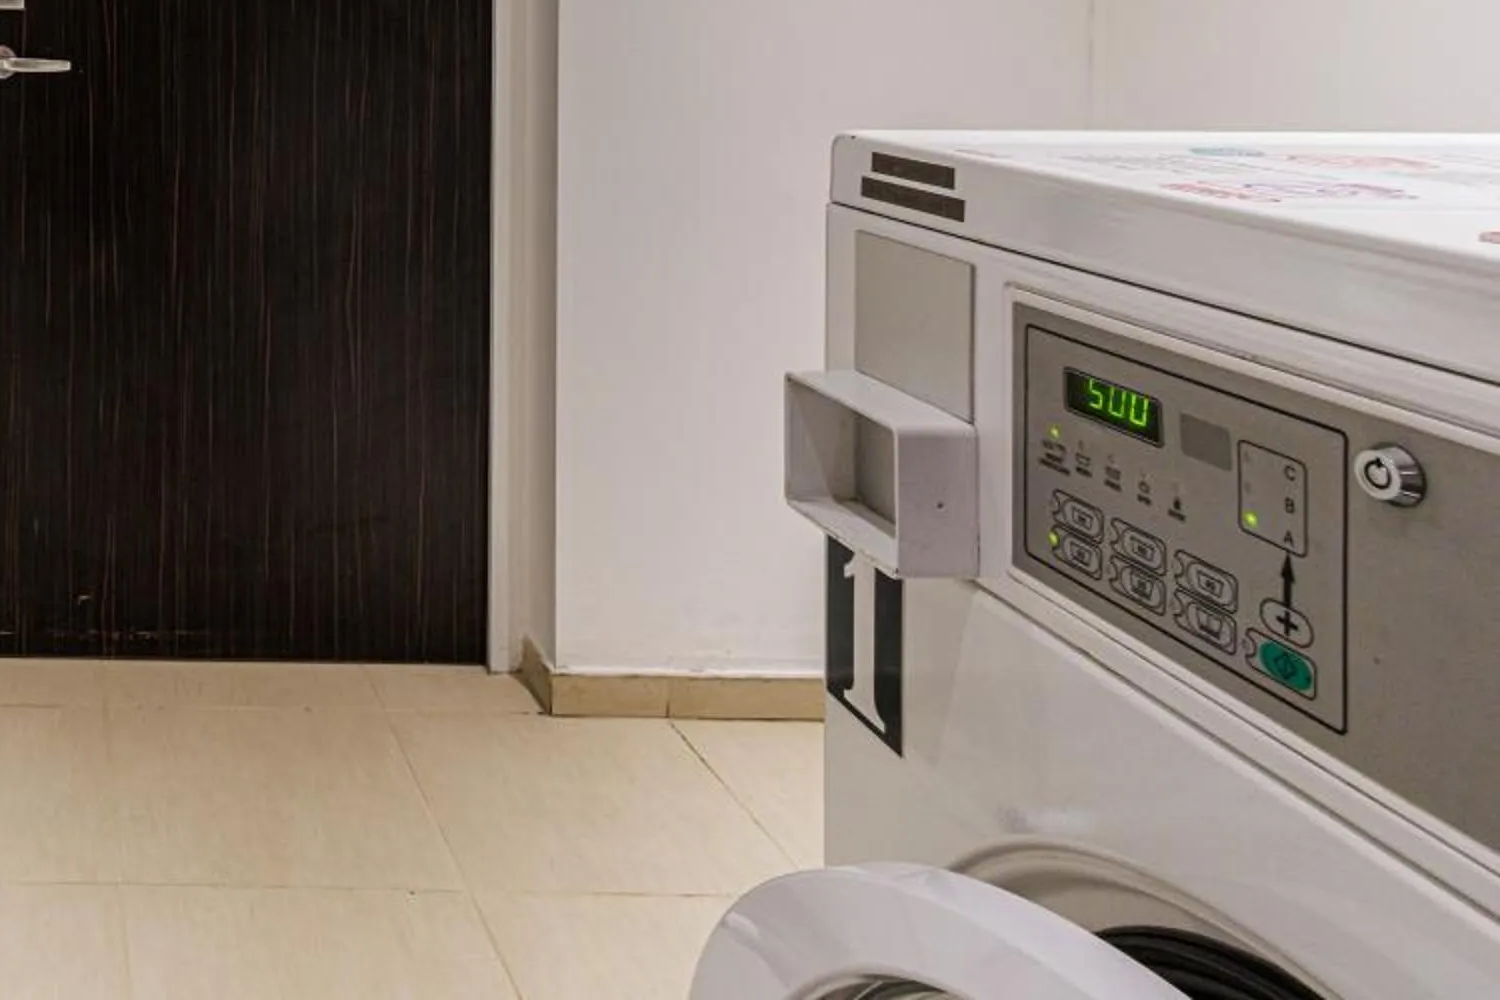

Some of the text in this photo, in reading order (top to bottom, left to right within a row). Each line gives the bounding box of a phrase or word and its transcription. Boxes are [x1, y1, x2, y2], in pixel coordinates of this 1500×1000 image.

[1283, 464, 1296, 482] C
[1284, 496, 1295, 514] B
[1283, 530, 1295, 549] A
